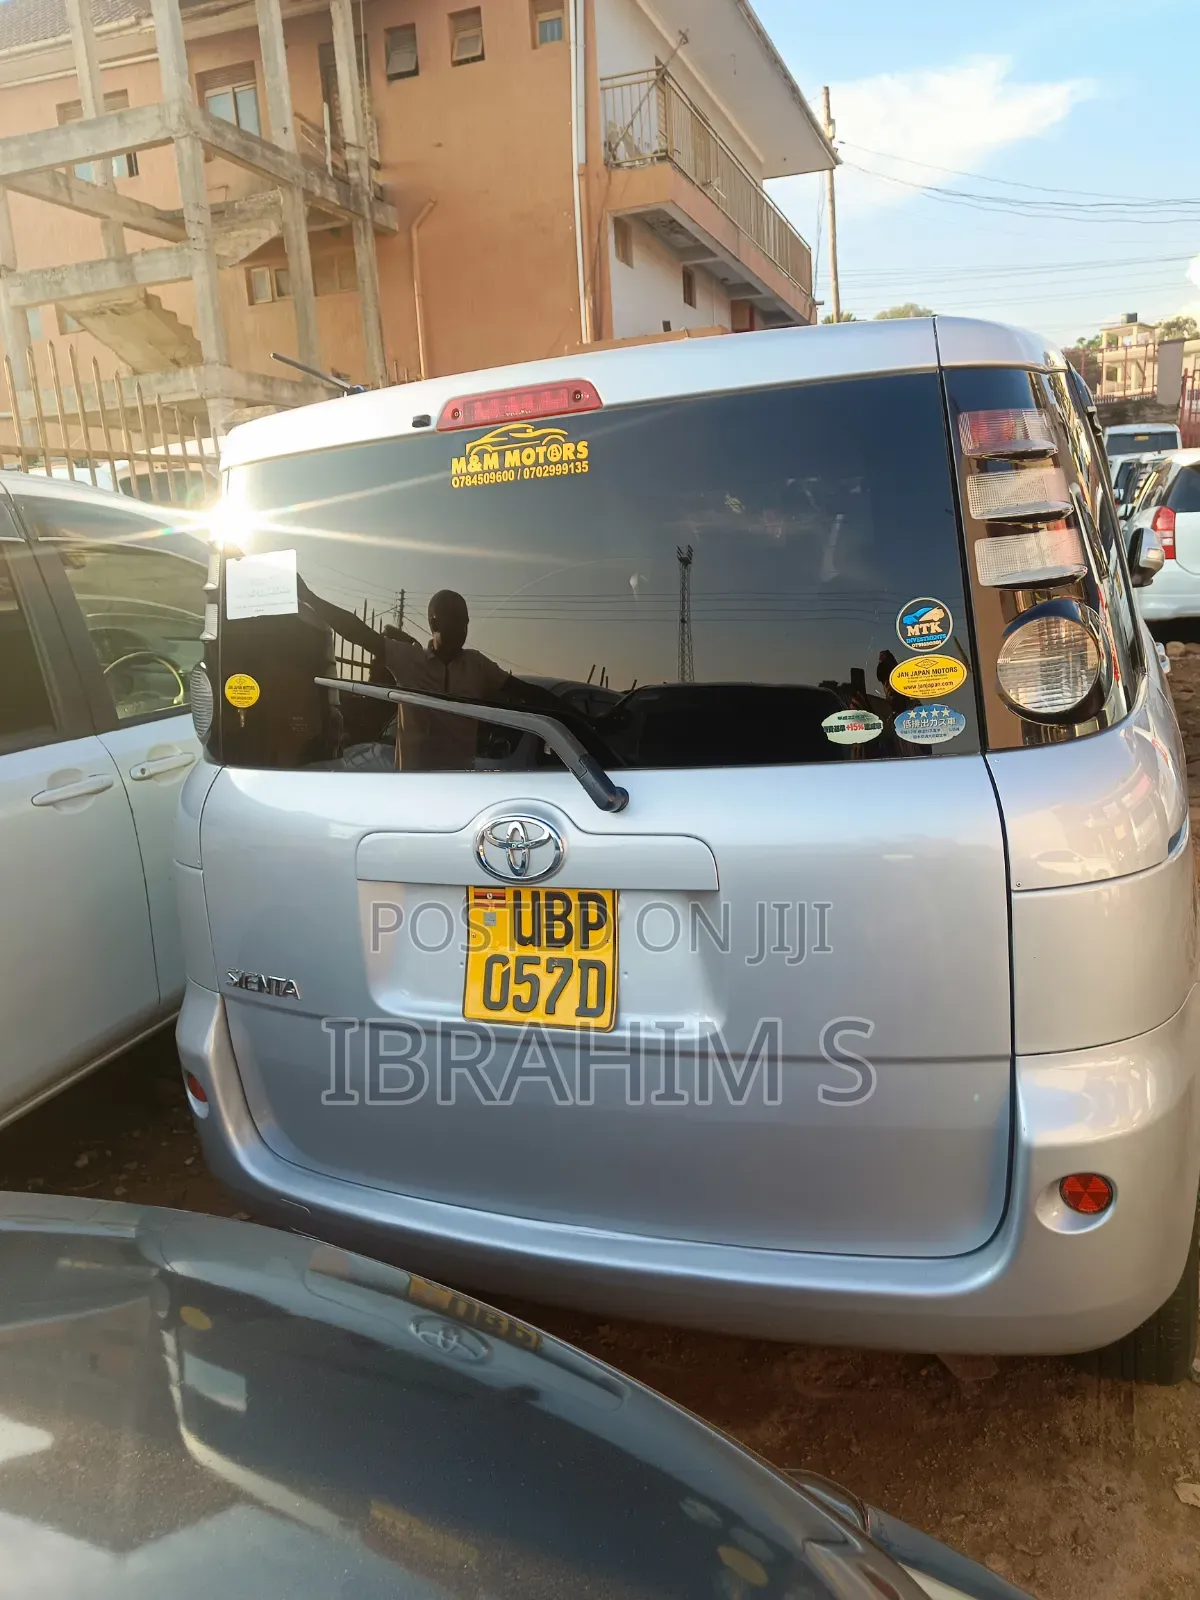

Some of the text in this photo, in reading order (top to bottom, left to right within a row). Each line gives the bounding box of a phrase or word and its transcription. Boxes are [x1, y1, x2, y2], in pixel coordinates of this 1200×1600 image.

[451, 441, 589, 475] M&M MOTORS
[451, 469, 515, 488] 0784509600
[523, 461, 589, 480] 0702999135
[906, 621, 943, 637] MTK
[910, 669, 931, 677] JAPAN
[931, 666, 958, 675] MOTORS
[513, 889, 608, 949] UBP
[482, 953, 607, 1018] 057D
